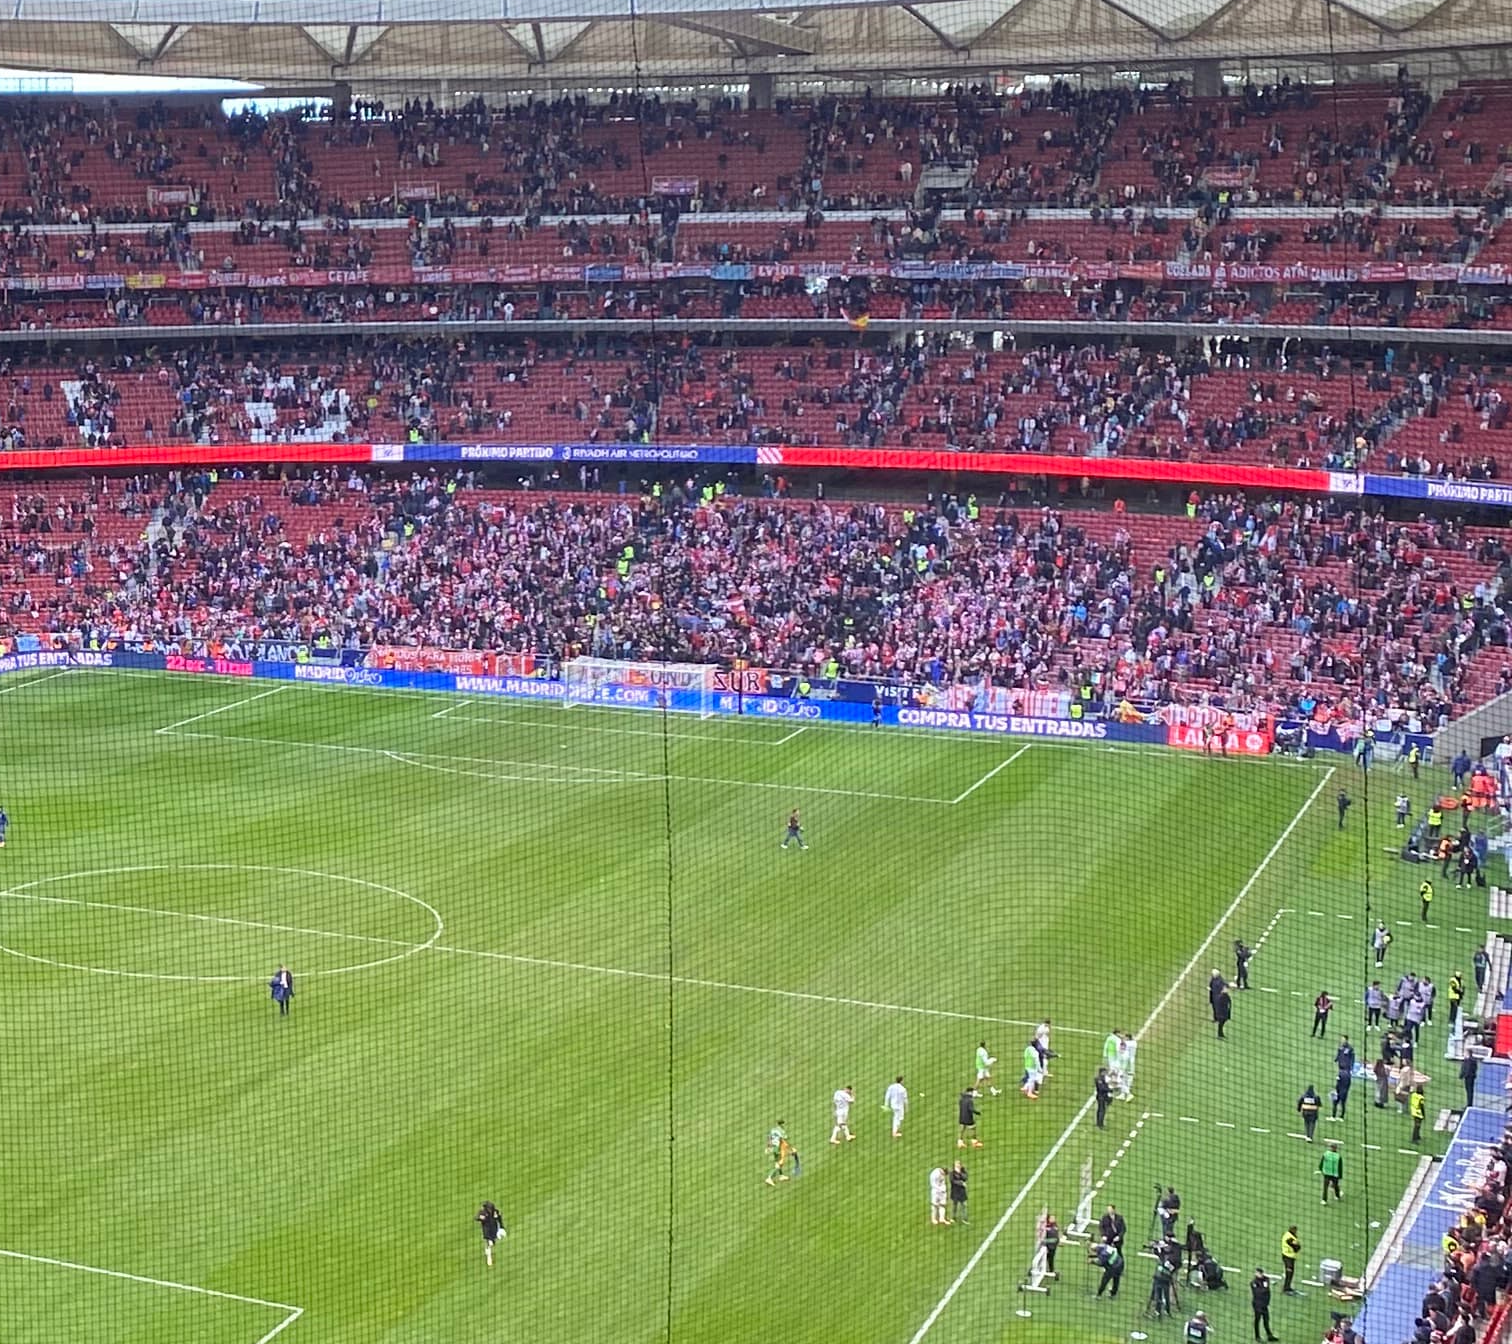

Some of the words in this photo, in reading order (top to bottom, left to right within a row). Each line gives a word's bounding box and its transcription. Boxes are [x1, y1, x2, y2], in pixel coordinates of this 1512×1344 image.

[461, 444, 507, 457] PRÓXIMO
[509, 446, 553, 458] PARTIDO
[573, 449, 609, 458] RIYADH
[611, 449, 627, 458] AIR
[1427, 482, 1479, 499] PRÓXIMO
[17, 655, 37, 668] TUS
[295, 664, 345, 680] MADRID
[875, 685, 911, 699] VISIT
[898, 708, 970, 730] COMPRA
[974, 713, 1008, 731] TUS
[1011, 717, 1107, 738] ENTRADAS
